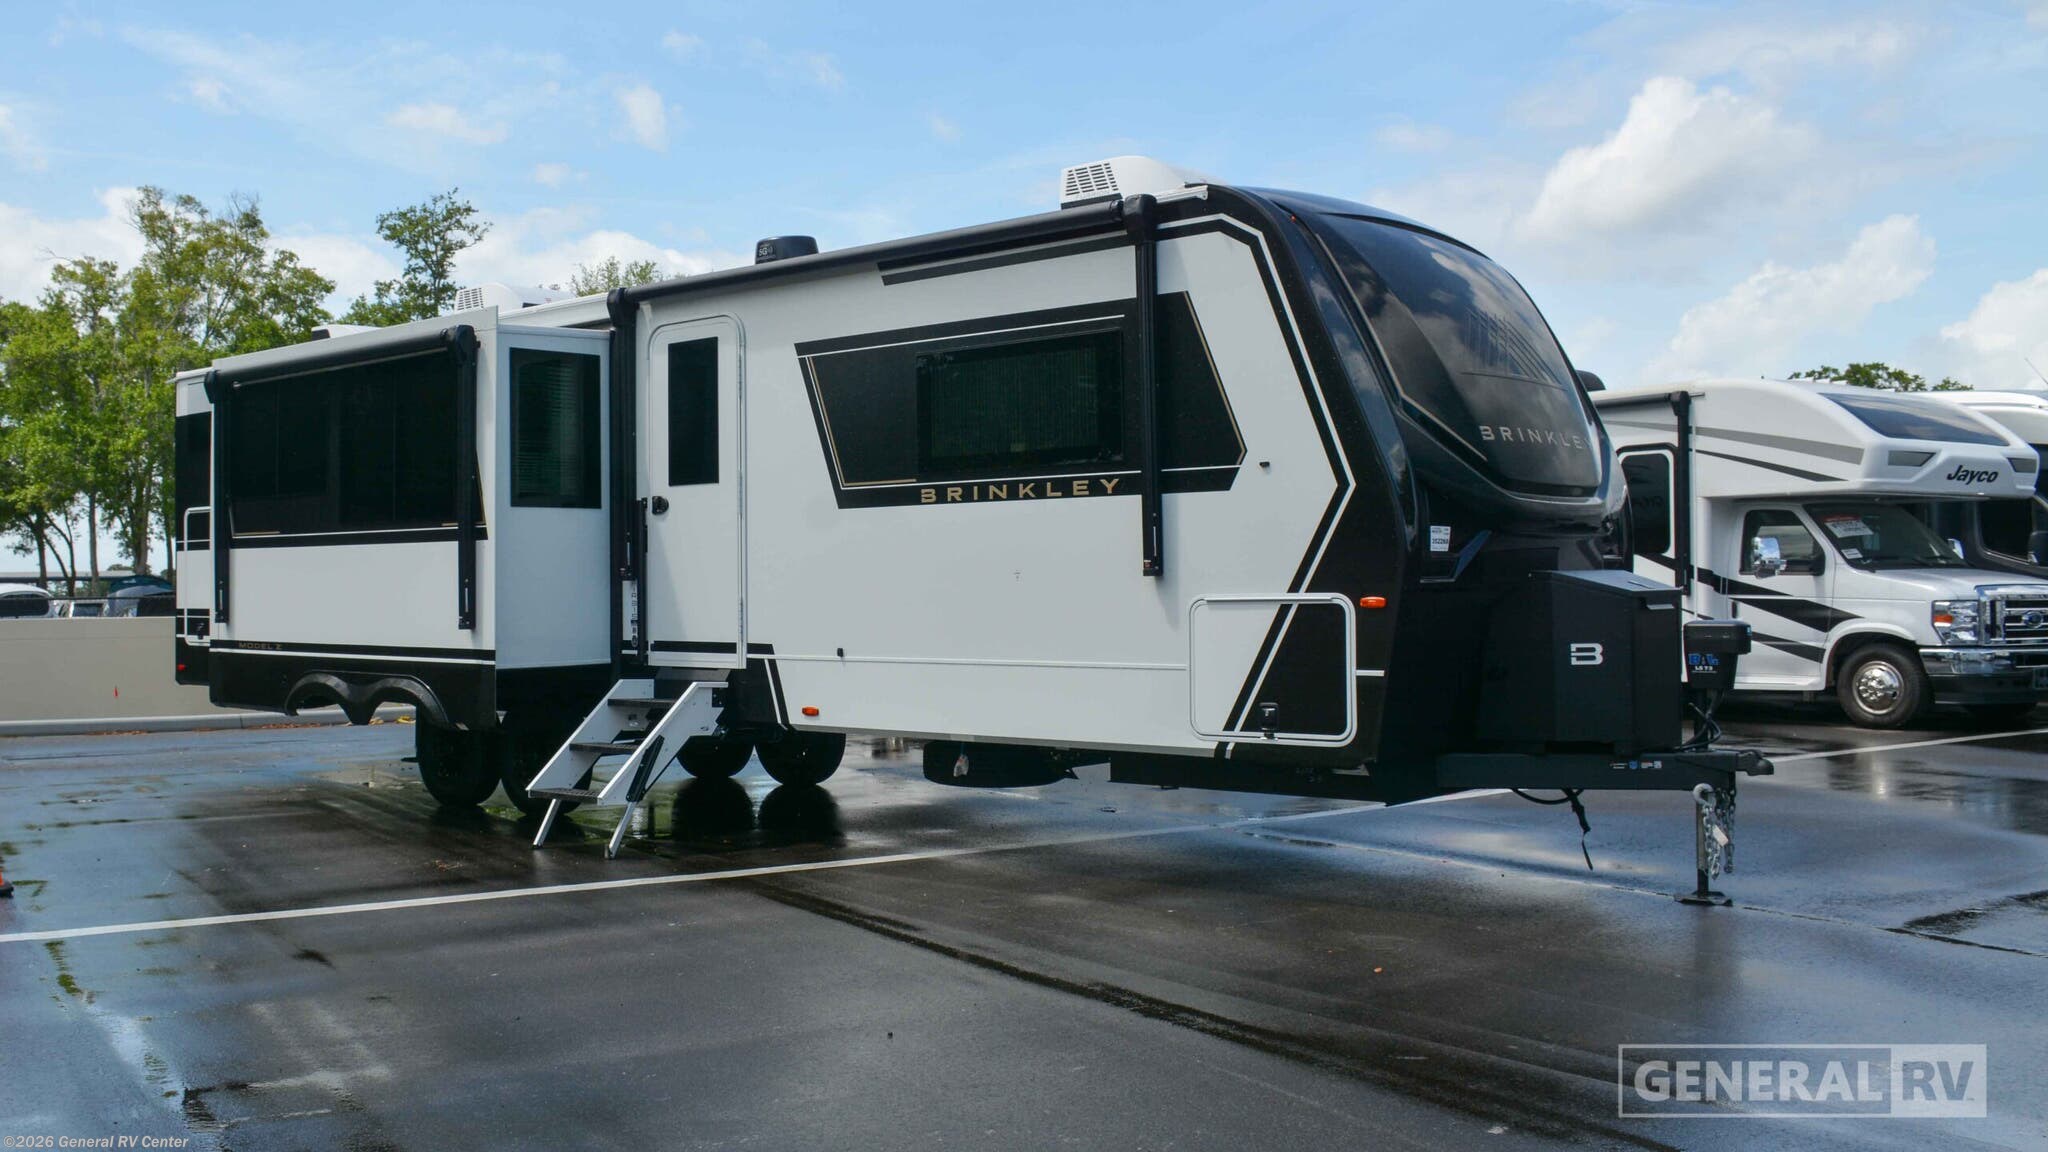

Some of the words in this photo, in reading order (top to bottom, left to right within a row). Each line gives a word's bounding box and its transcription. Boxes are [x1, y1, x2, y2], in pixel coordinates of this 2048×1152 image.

[1946, 464, 1999, 485] Jayco
[920, 478, 1120, 503] BRINKLEY
[1570, 643, 1604, 666] B
